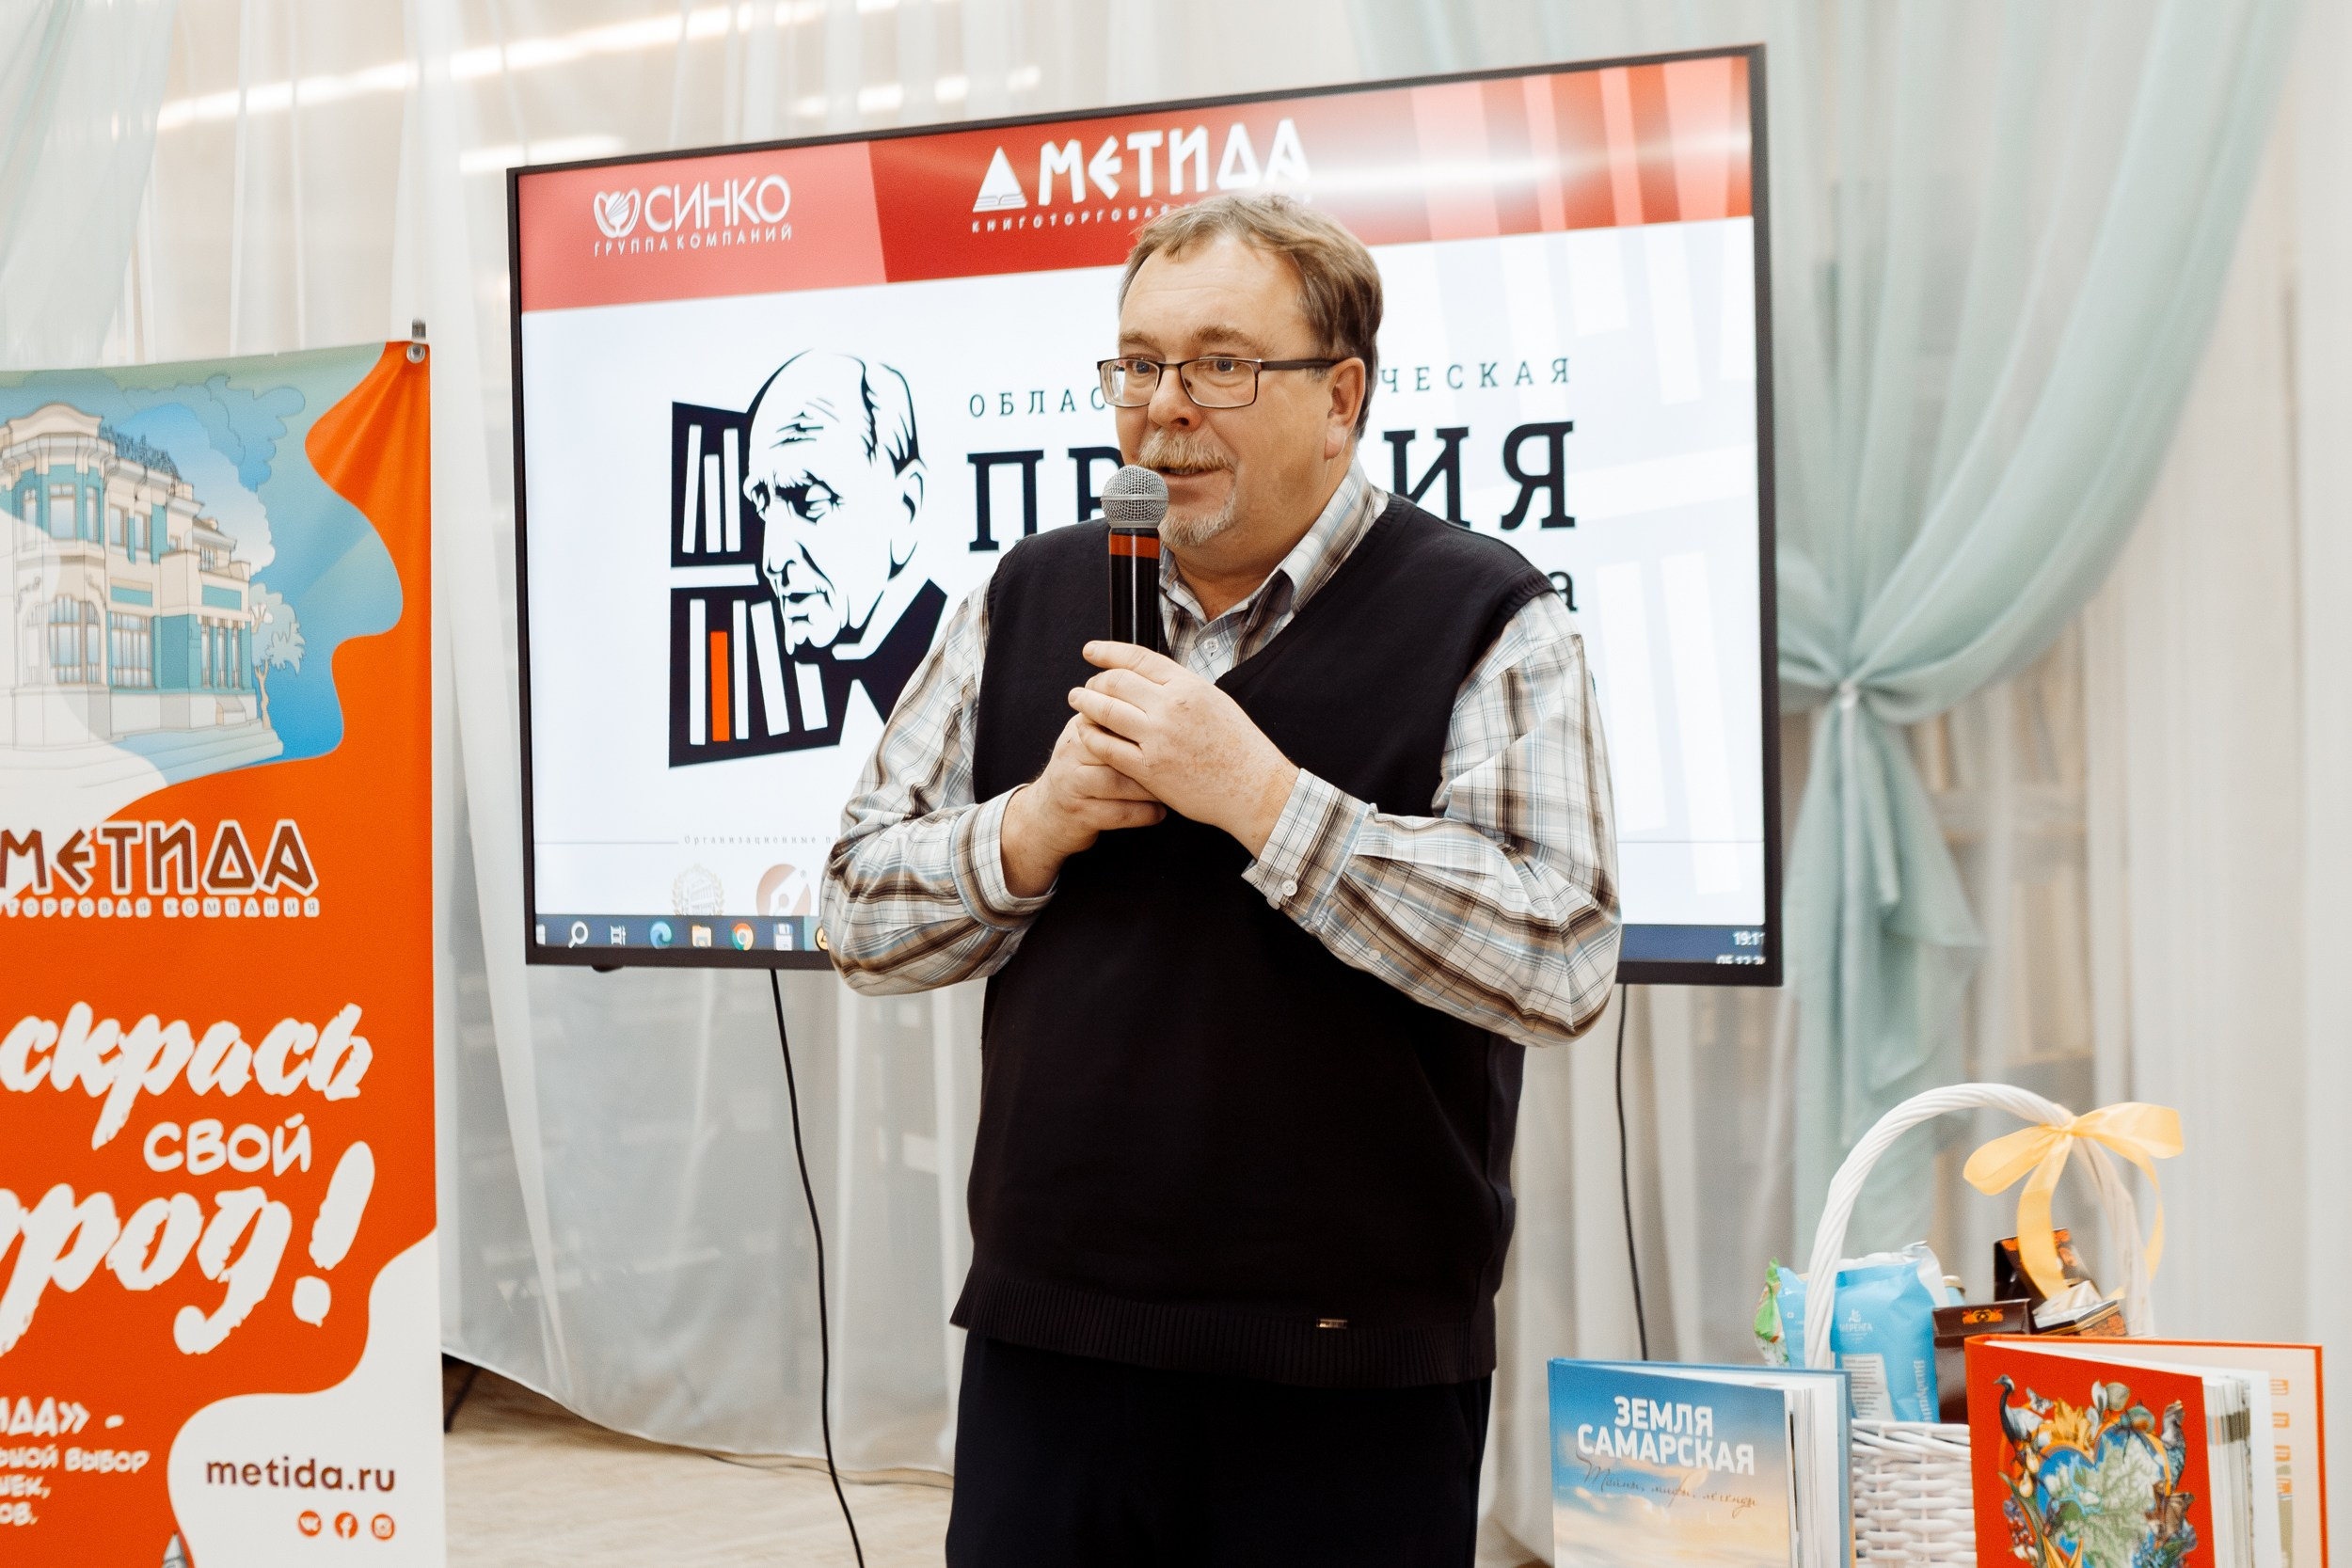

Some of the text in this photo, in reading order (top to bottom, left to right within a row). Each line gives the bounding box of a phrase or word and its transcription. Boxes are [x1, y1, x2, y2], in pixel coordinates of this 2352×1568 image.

[1038, 118, 1311, 206] МЕТИДА
[644, 174, 791, 232] СИНКО
[972, 204, 1169, 233] КНИГОТОРГОВАЯ
[594, 223, 792, 257] ГРУППА КОМПАНИЙ
[969, 358, 1571, 418] ОБЛАС ЧЕСКАЯ
[0, 819, 319, 895] МЕТИДА
[0, 896, 320, 918] ТОРГОВАЯ КОМПАНИЯ
[1613, 1396, 1713, 1438] ЗЕМЛЯ
[64, 1446, 151, 1474] ВЫБОР
[1577, 1423, 1756, 1476] САМАРСКАЯ
[206, 1455, 395, 1492] metida.ru
